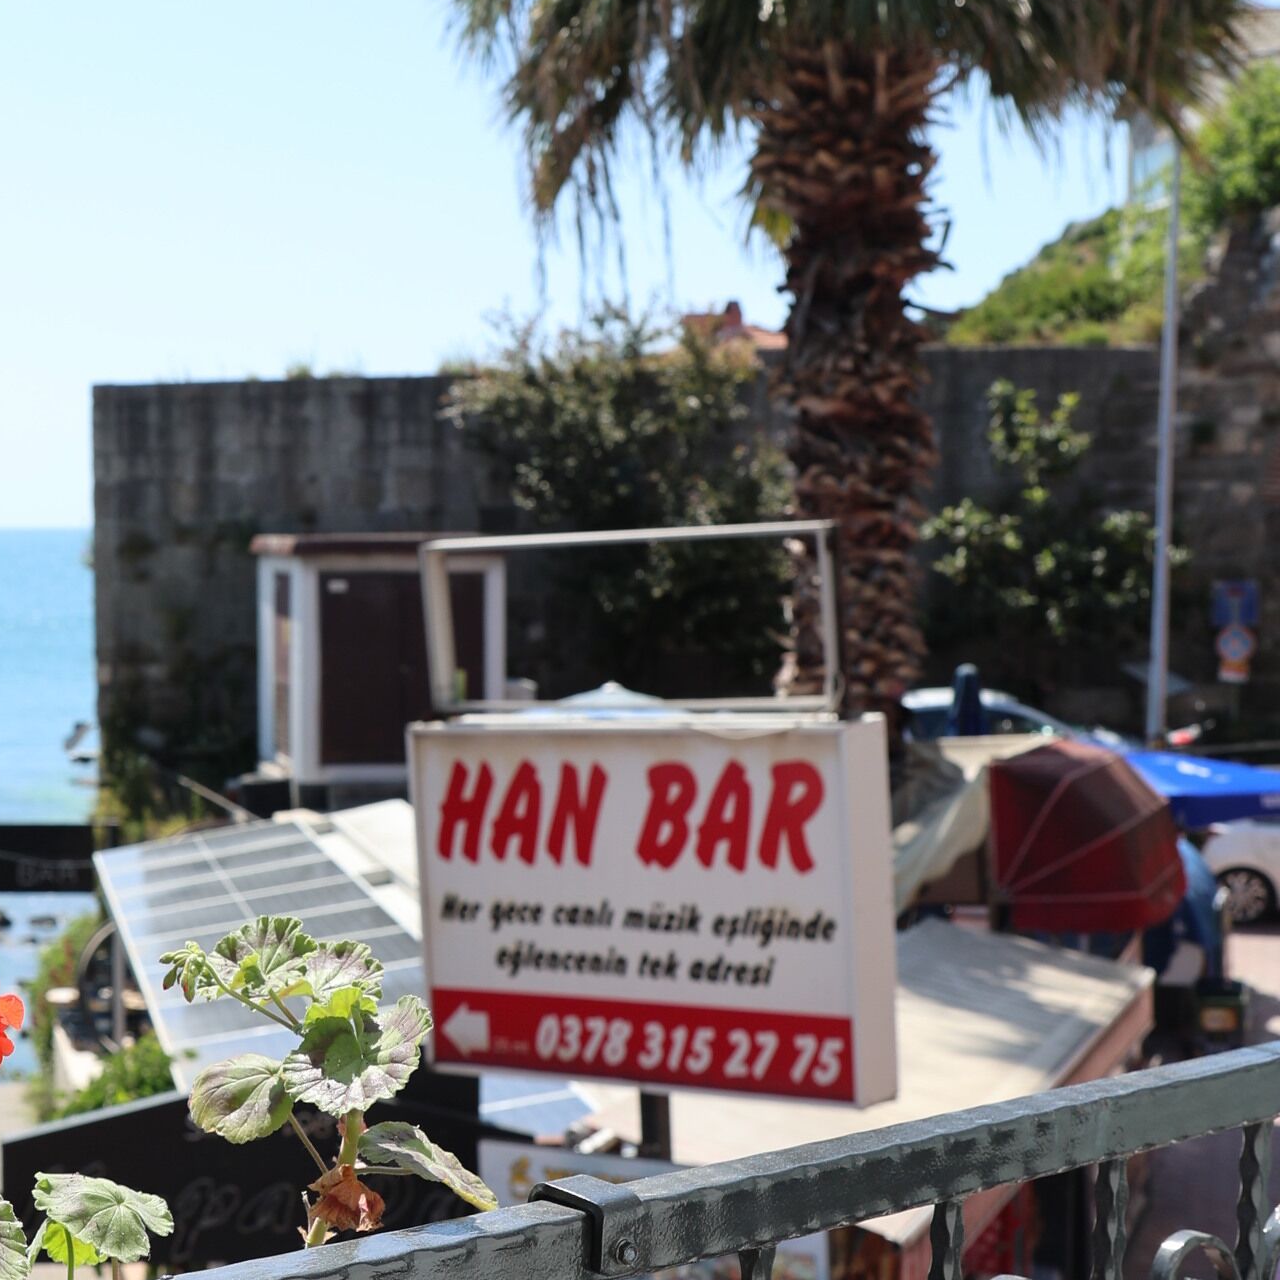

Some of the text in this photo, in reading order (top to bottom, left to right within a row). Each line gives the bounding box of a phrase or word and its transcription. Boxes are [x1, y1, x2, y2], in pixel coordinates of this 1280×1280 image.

[437, 759, 825, 873] HAN BAR
[440, 893, 837, 946] Her gece canlı müzik eşliğinde
[495, 941, 774, 986] eğlencenin tek adresi
[534, 1015, 844, 1086] 0378 315 27 75
